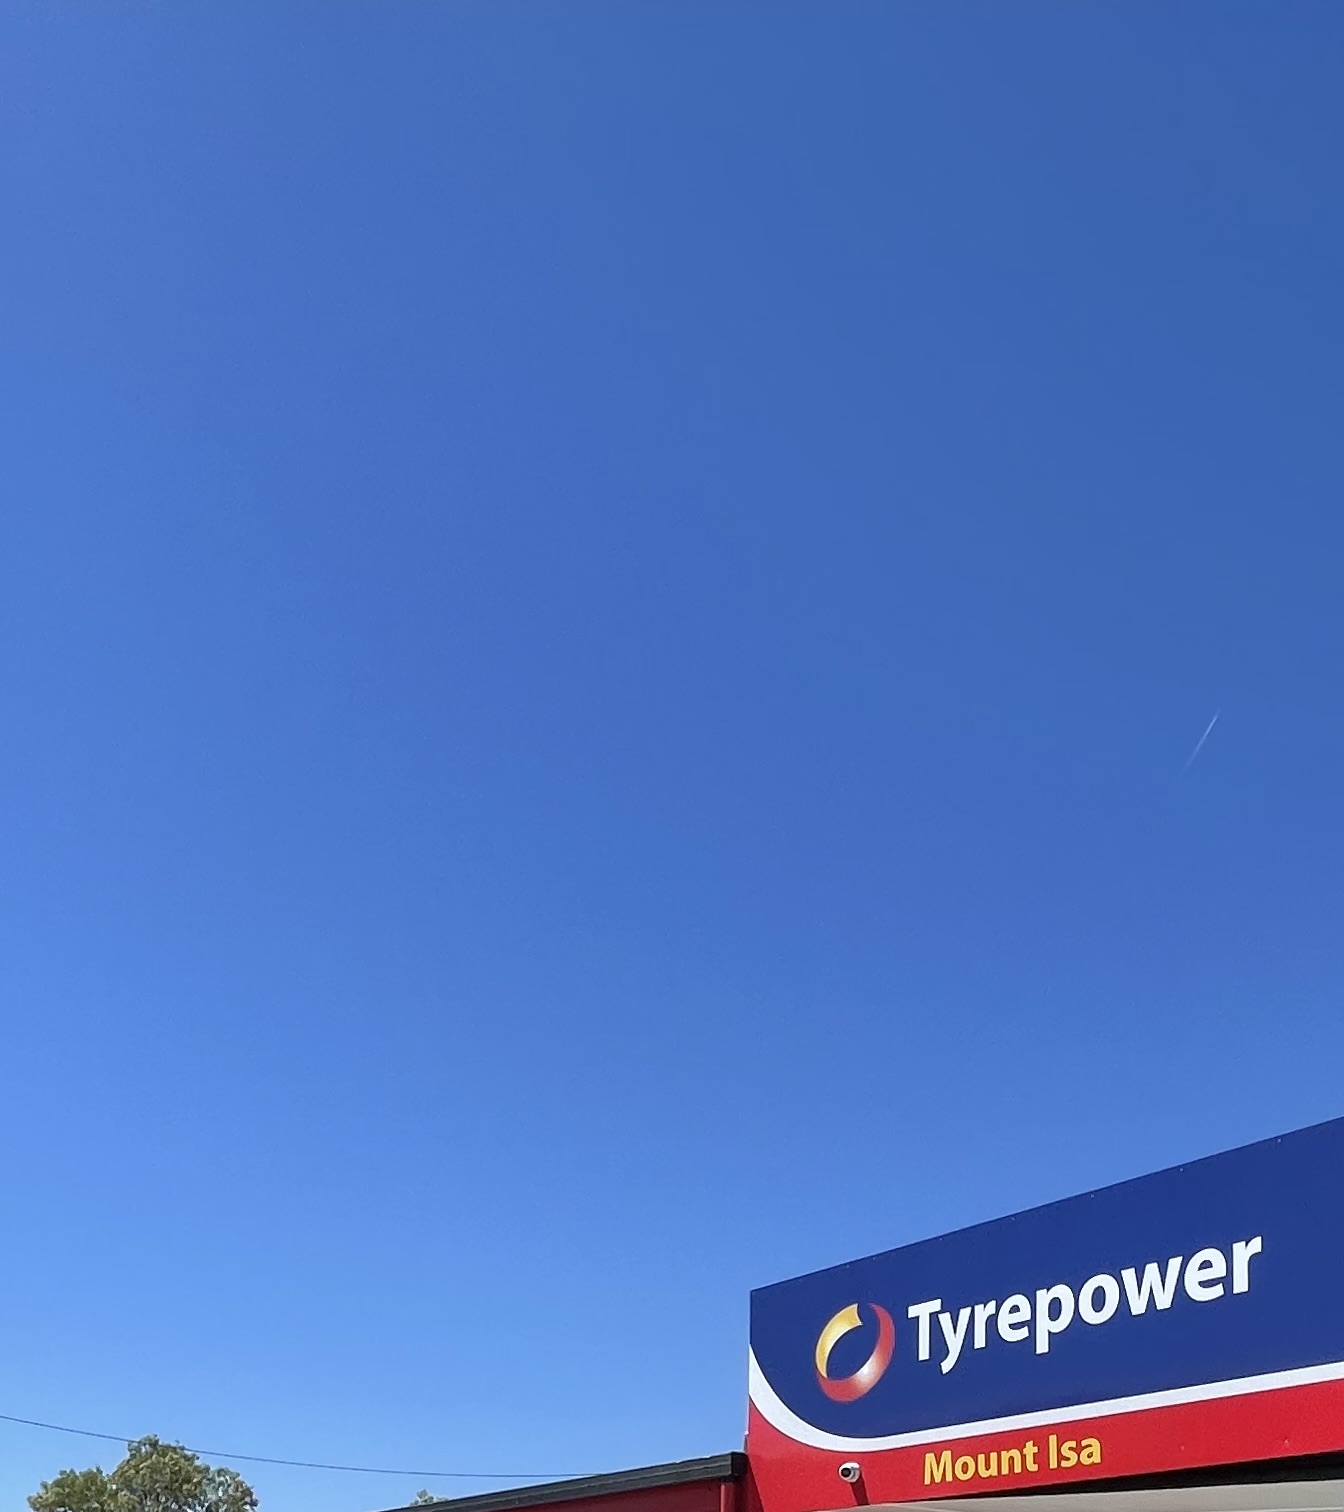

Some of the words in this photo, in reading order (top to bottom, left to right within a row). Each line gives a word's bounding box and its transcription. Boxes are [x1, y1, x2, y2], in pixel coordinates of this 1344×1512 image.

[908, 1235, 1262, 1374] Tyrepower
[923, 1439, 1038, 1485] Mount
[1048, 1433, 1102, 1470] Isa
